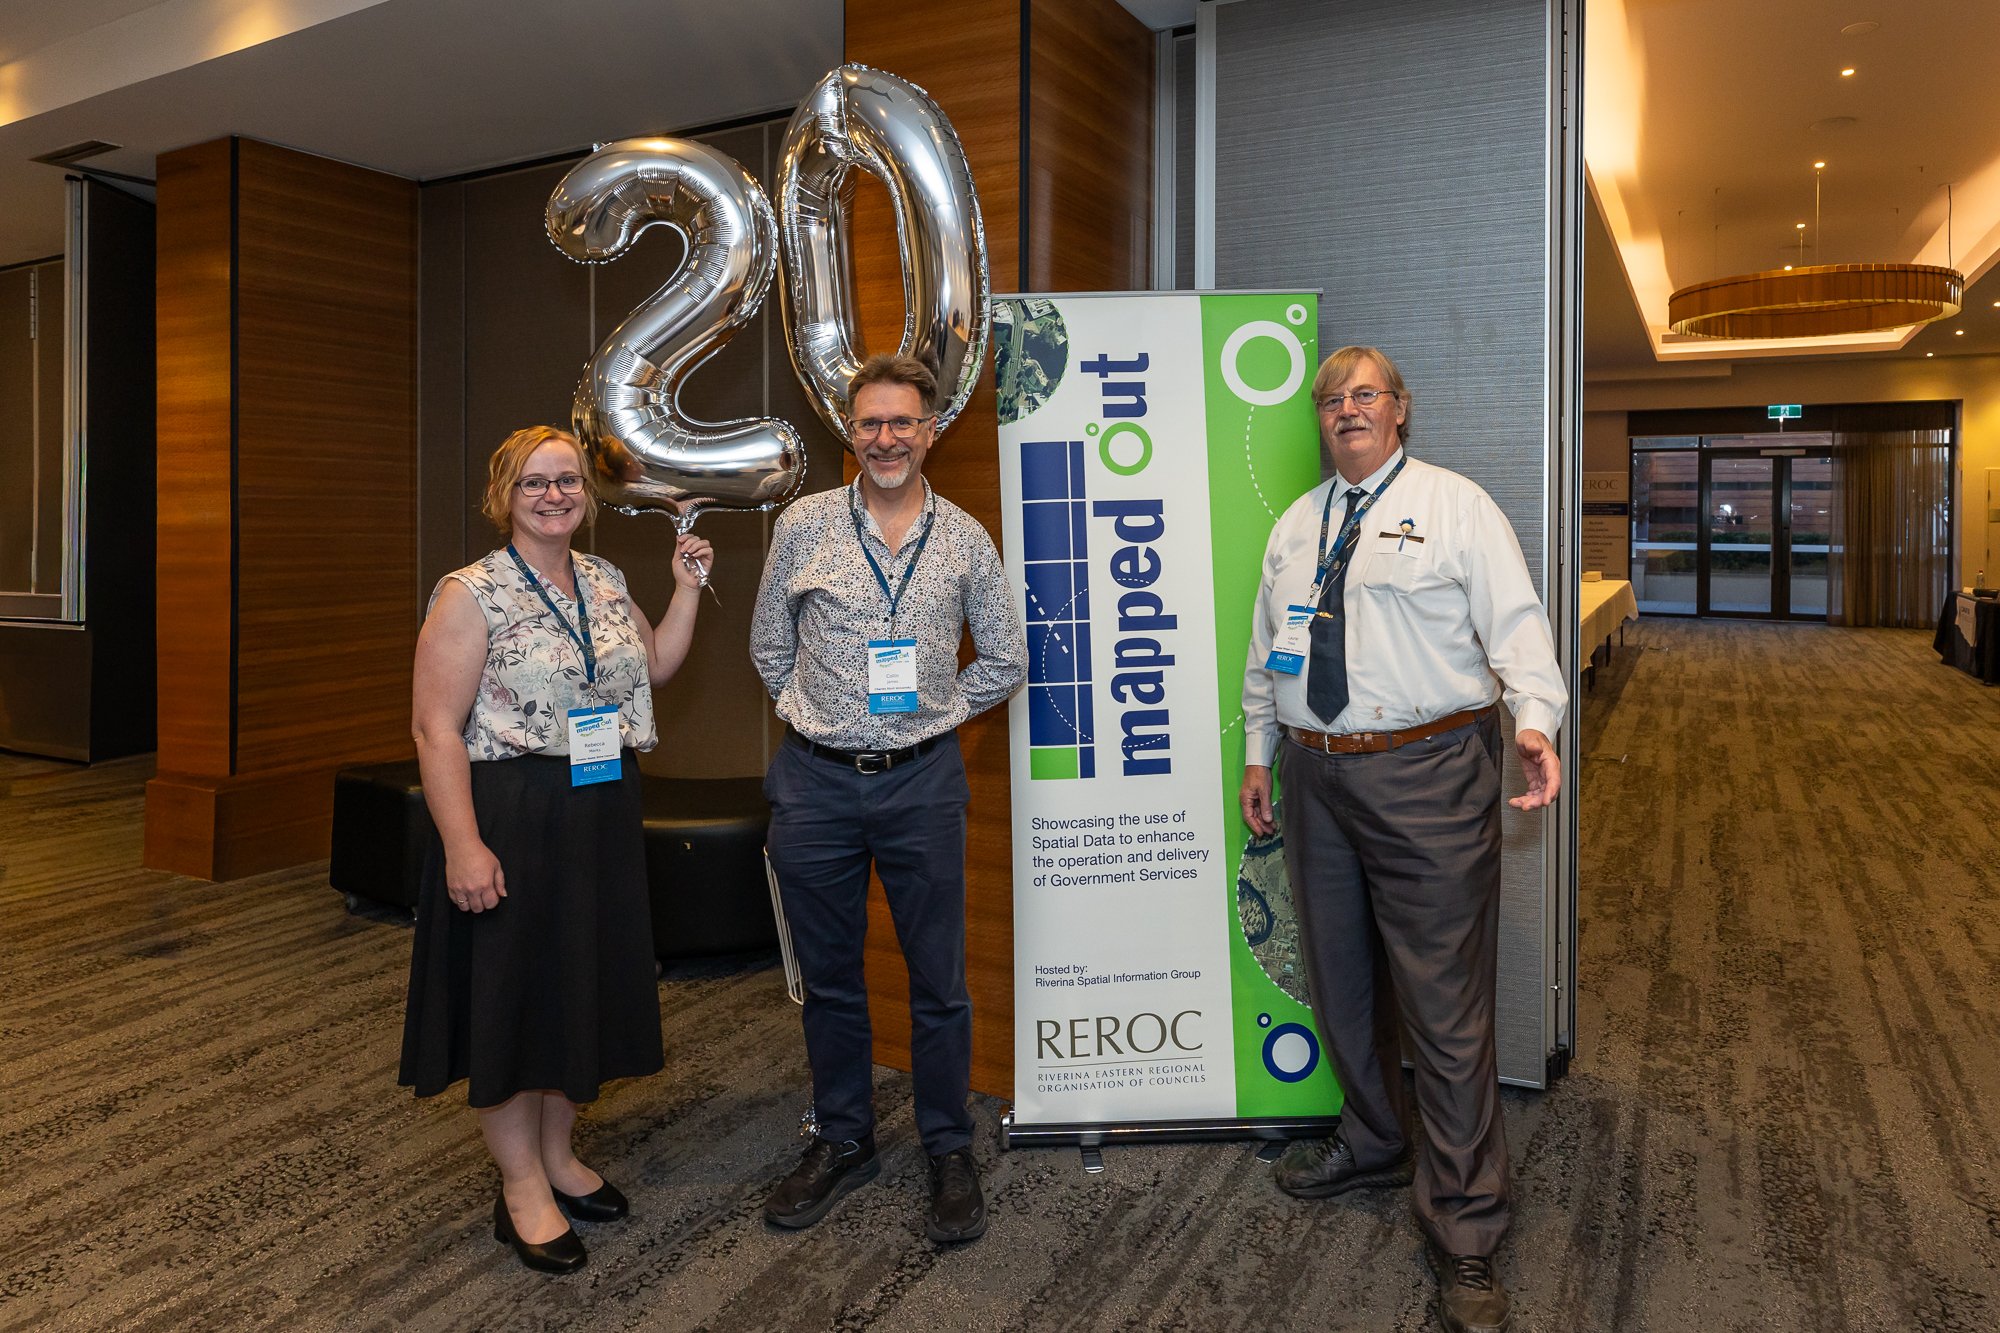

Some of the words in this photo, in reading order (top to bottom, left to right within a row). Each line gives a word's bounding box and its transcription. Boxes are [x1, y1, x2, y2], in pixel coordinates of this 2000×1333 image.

[1583, 479, 1618, 490] EROC
[1092, 499, 1178, 776] mapped
[583, 763, 608, 773] REROC
[1031, 815, 1115, 830] Showcasing
[1118, 813, 1140, 826] the
[1144, 814, 1169, 825] use
[1172, 810, 1186, 823] of
[1032, 835, 1079, 852] Spatial
[1083, 834, 1115, 847] Data
[1119, 833, 1133, 844] to
[1136, 830, 1195, 844] enhance
[1032, 855, 1054, 868] the
[1058, 852, 1123, 870] operation
[1127, 849, 1153, 863] and
[1156, 847, 1210, 862] delivery
[1033, 874, 1047, 887] of
[1050, 870, 1136, 887] Government
[1139, 867, 1198, 881] Services
[1035, 964, 1070, 975] Hosted
[1073, 964, 1088, 976] by:
[1035, 977, 1075, 988] Riverina
[1077, 974, 1111, 987] Spatial
[1113, 970, 1168, 983] Information
[1170, 969, 1201, 979] Group
[1036, 1010, 1203, 1059] REROC
[1038, 1071, 1090, 1082] RIVERINA
[1095, 1067, 1144, 1079] EASTERN
[1148, 1063, 1206, 1075] REGIONAL
[1038, 1080, 1124, 1093] ORGANISATION
[1129, 1078, 1144, 1088] OF
[1149, 1074, 1206, 1086] COUNCILS
